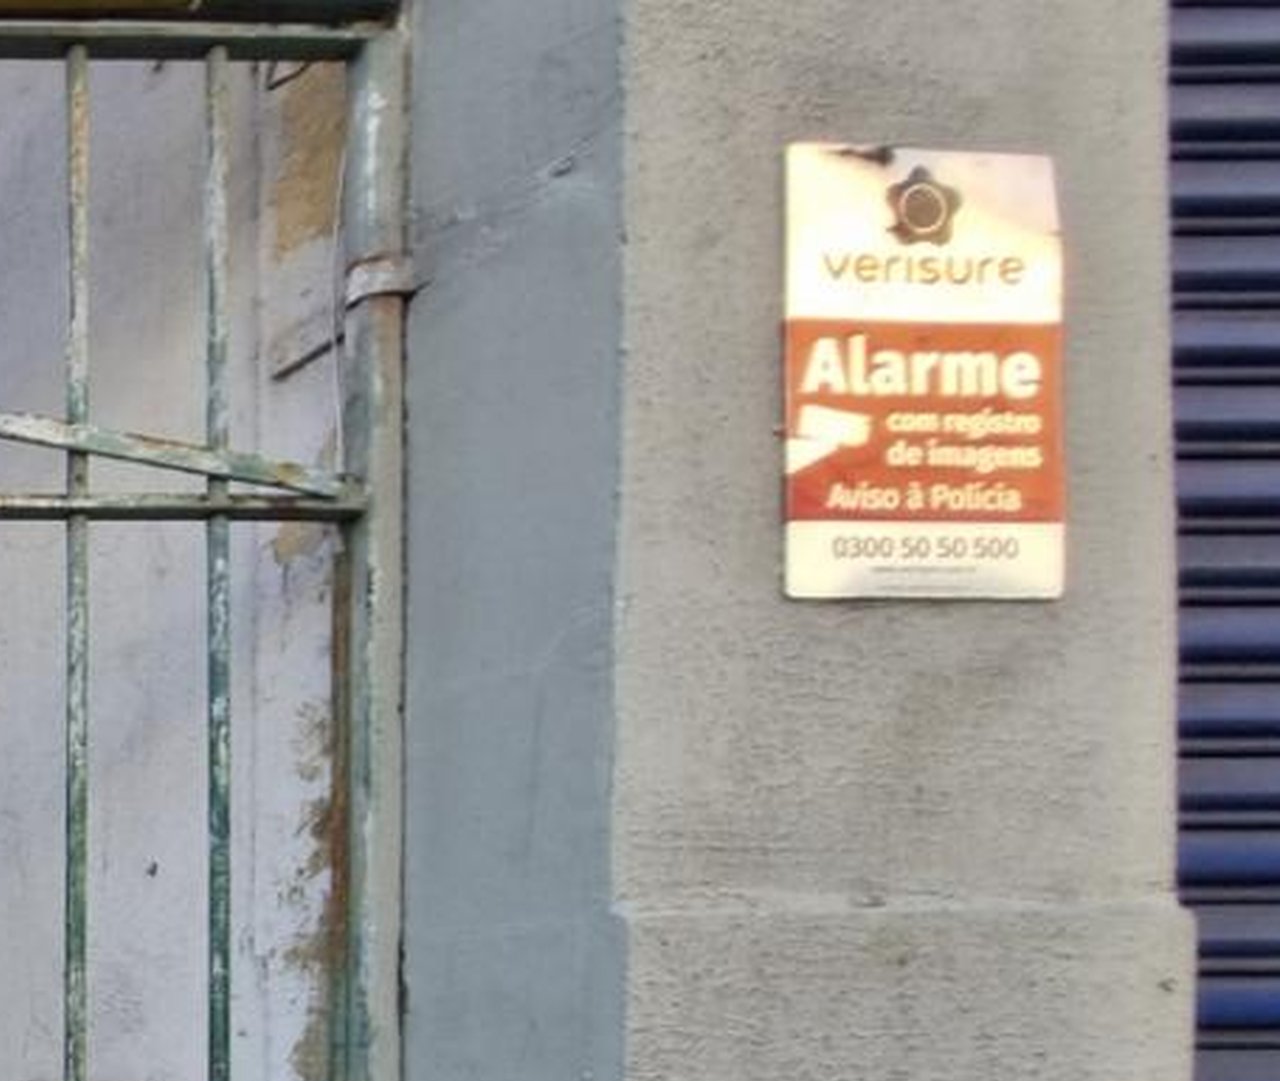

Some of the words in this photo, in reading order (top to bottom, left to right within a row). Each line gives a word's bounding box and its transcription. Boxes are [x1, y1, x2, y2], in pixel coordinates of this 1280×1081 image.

[823, 252, 1026, 285] verisure
[802, 335, 1042, 398] Alarme
[886, 413, 940, 432] com
[943, 407, 1042, 438] registro
[886, 439, 923, 467] de
[926, 438, 1043, 473] imagens
[826, 482, 901, 510] Aviso
[906, 481, 925, 509] à
[930, 481, 1023, 511] Polícia
[831, 535, 895, 559] 0300
[901, 536, 932, 559] 50
[937, 536, 968, 559] 50
[973, 536, 1019, 559] 500
